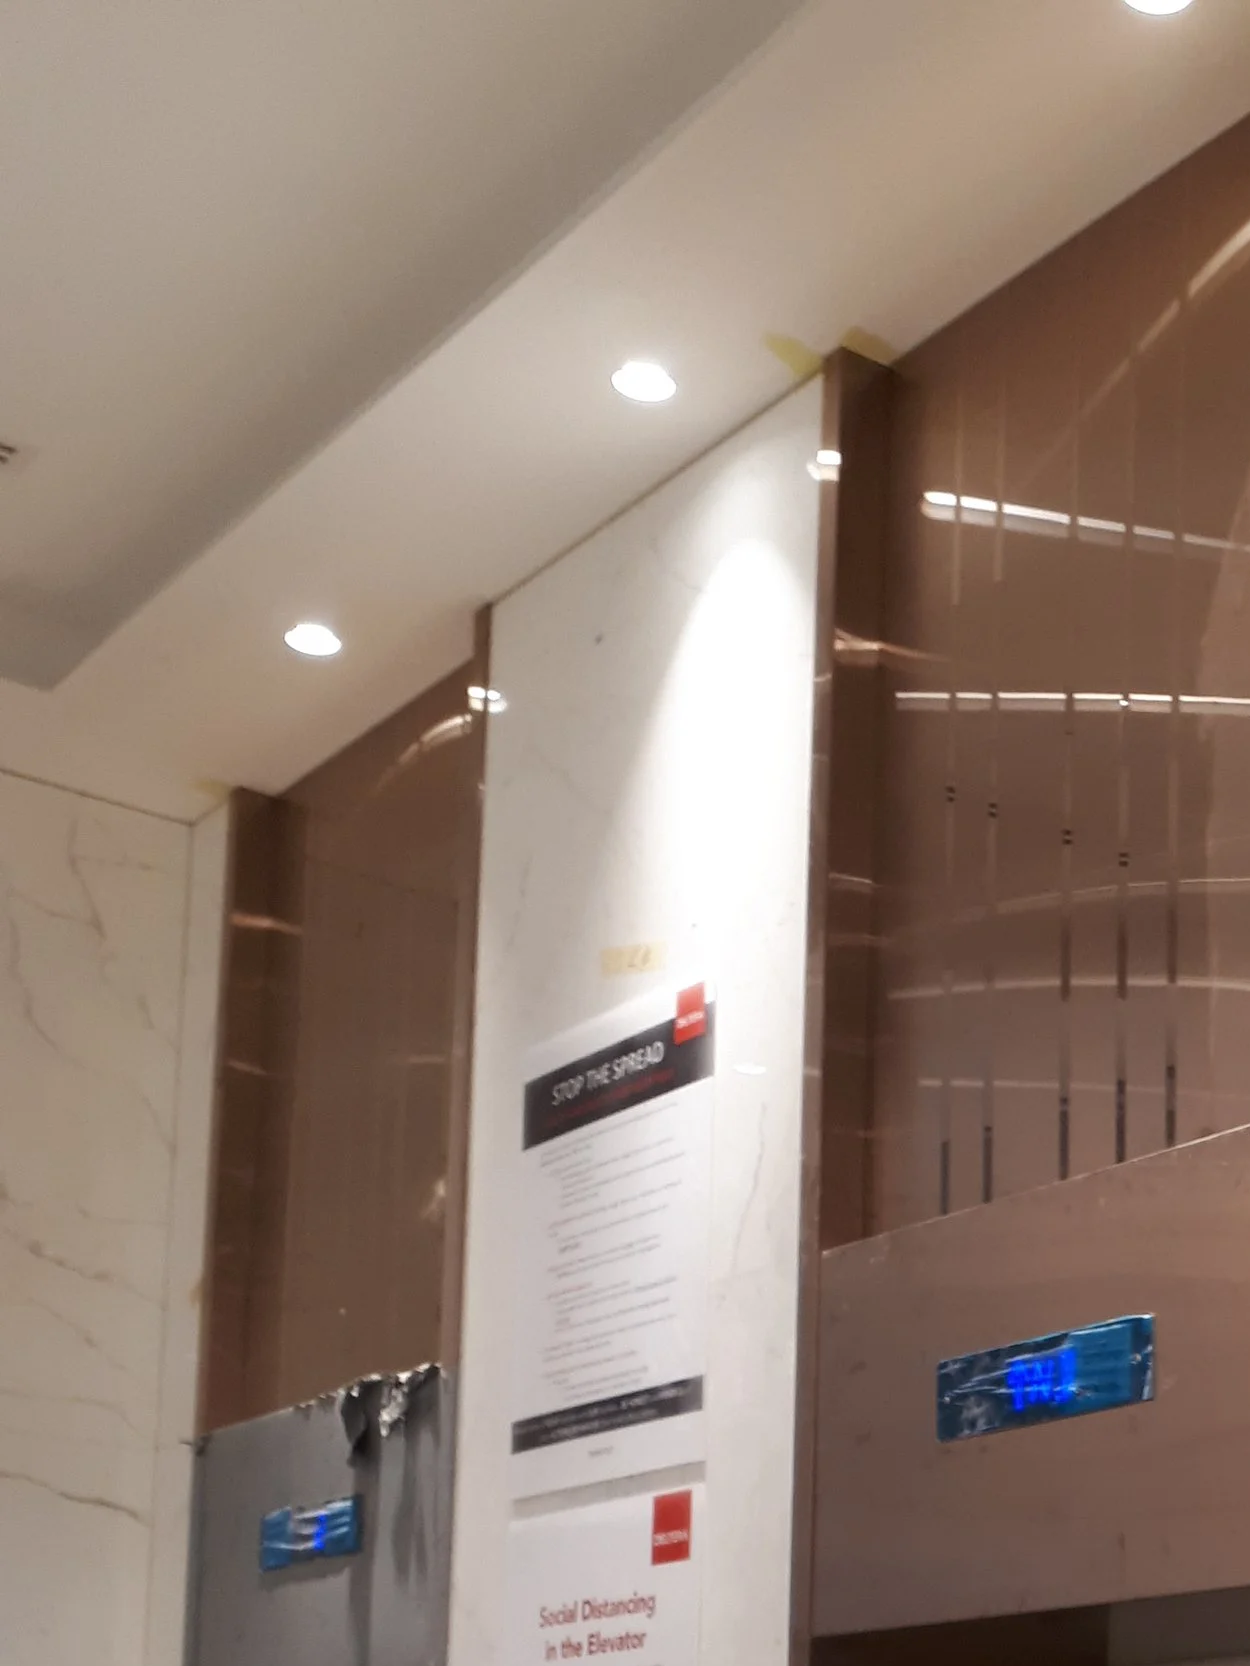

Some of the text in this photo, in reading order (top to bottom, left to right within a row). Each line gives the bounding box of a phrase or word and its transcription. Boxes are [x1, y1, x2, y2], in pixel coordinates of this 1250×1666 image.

[539, 1591, 656, 1629] Social Distancing
[561, 1637, 582, 1659] the
[587, 1632, 647, 1655] Elevator
